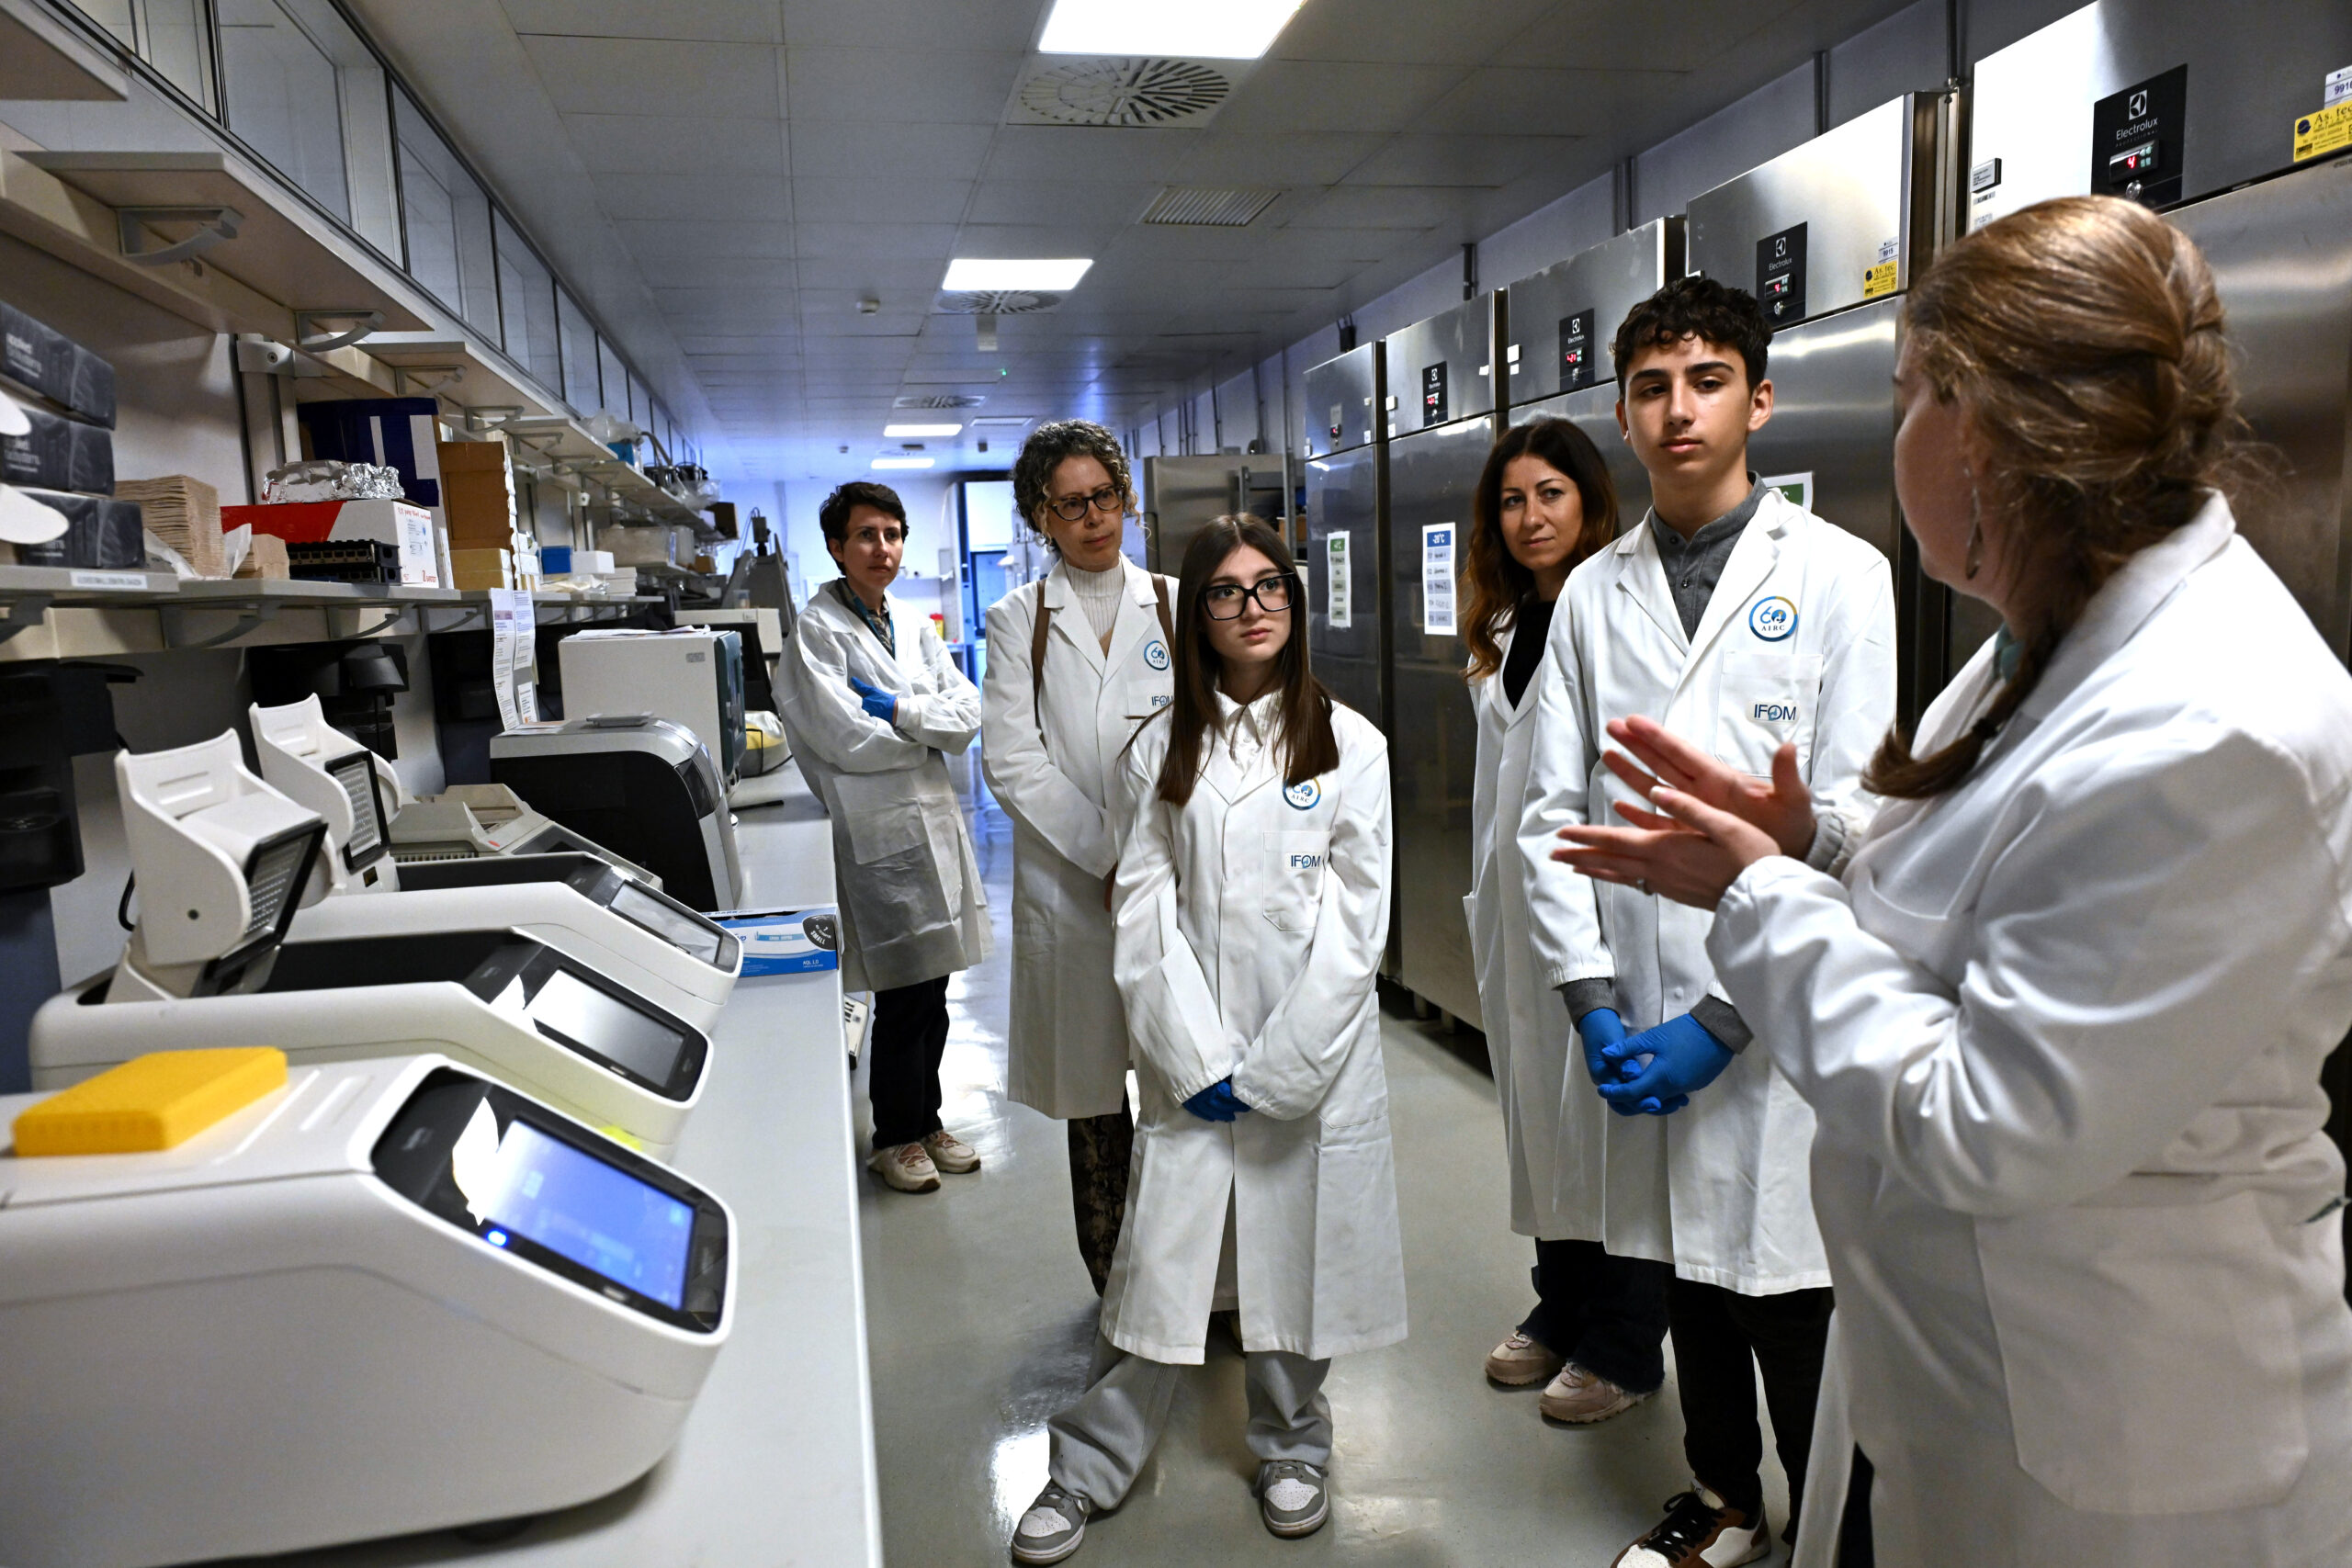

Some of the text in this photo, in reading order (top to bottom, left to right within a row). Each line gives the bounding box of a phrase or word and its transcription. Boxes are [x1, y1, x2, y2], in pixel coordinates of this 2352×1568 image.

[2116, 117, 2158, 141] Electrolux
[2128, 155, 2136, 169] 4
[1769, 257, 1792, 271] Electrolux
[1753, 704, 1797, 722] IFOM
[1291, 794, 1310, 804] AIRC
[1290, 854, 1321, 869] IFOM
[810, 930, 826, 945] SMALL
